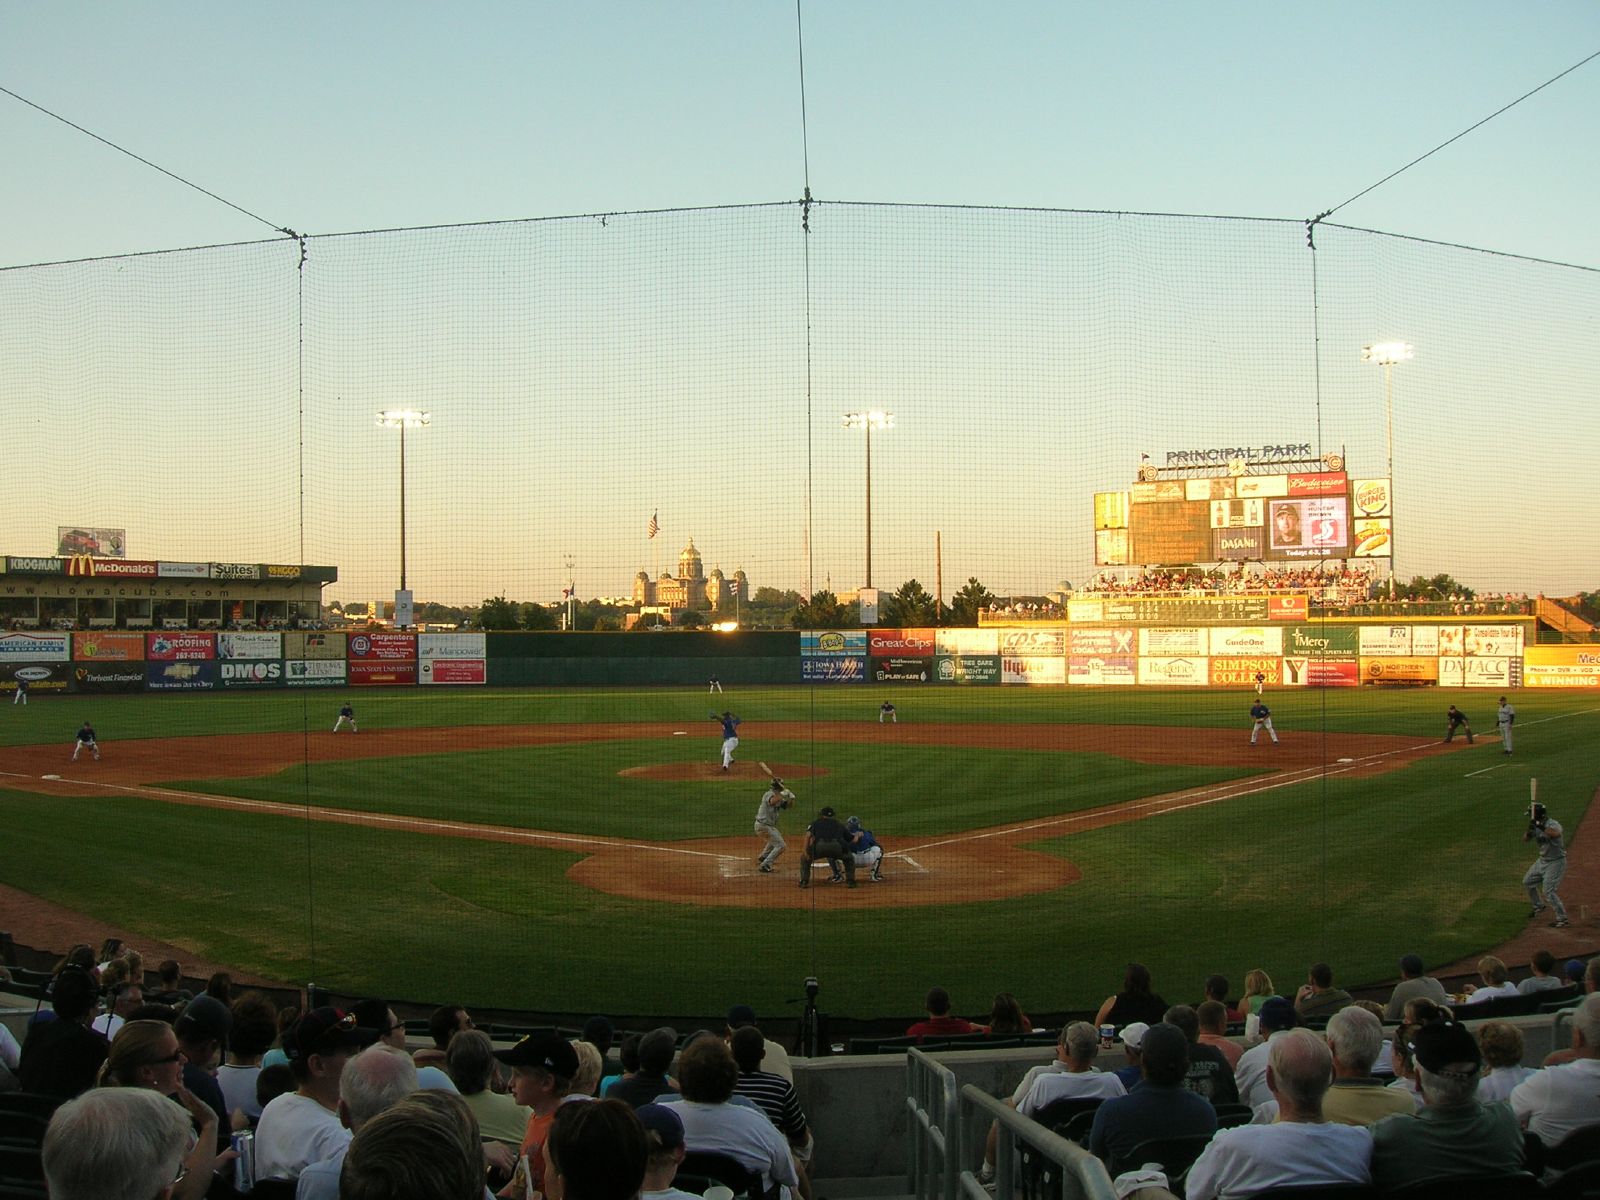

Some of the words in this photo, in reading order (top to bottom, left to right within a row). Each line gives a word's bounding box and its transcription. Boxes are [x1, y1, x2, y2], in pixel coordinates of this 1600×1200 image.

[1166, 446, 1258, 463] PRINCIPAL
[1263, 443, 1311, 458] PARK
[1290, 477, 1345, 489] Budweiser
[1358, 486, 1385, 499] BURGER
[1360, 493, 1386, 508] KING
[1221, 536, 1256, 550] DASANI
[10, 558, 60, 571] KROGMAN
[95, 563, 156, 574] McDonald's
[215, 564, 253, 575] Suites
[370, 633, 415, 641] Carpenters
[1225, 638, 1265, 646] GuideOne
[172, 639, 211, 648] ROOFING
[871, 637, 904, 648] Great
[905, 637, 933, 650] Clips
[1299, 636, 1330, 651] Mercy
[439, 647, 482, 657] Manpower
[221, 662, 281, 679] DMOS
[815, 661, 835, 669] IOWA
[1149, 661, 1197, 676] Regency
[1213, 659, 1278, 671] SIMPSON
[1443, 659, 1508, 674] DMACC
[87, 674, 113, 682] Thrivent
[114, 673, 144, 681] Financial
[1528, 676, 1537, 685] A
[1540, 675, 1598, 686] WINNING
